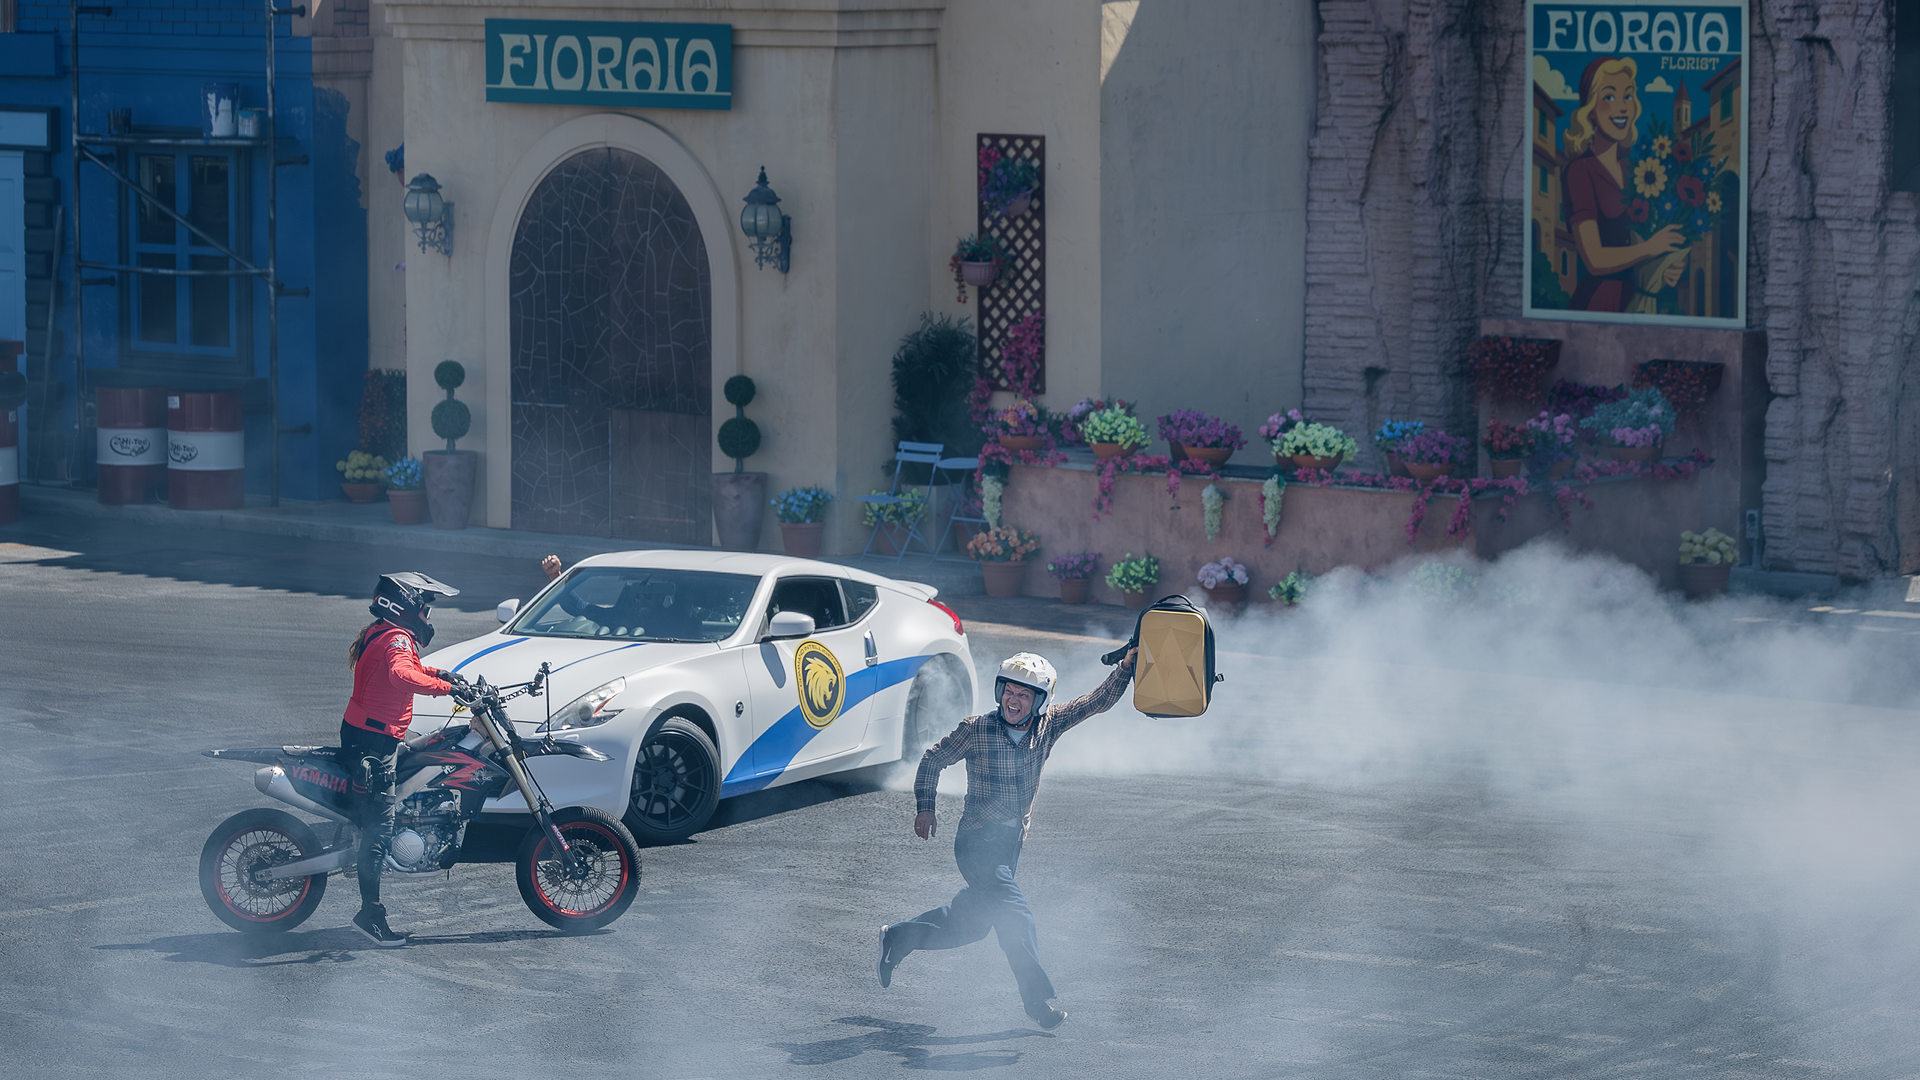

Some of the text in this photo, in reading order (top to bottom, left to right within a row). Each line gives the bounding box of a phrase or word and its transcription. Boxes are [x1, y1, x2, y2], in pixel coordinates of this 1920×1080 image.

[1546, 10, 1729, 53] FIORAIA
[499, 33, 718, 93] FIORAIA
[1660, 56, 1720, 71] FLORIST
[292, 765, 348, 794] YAMAHA
